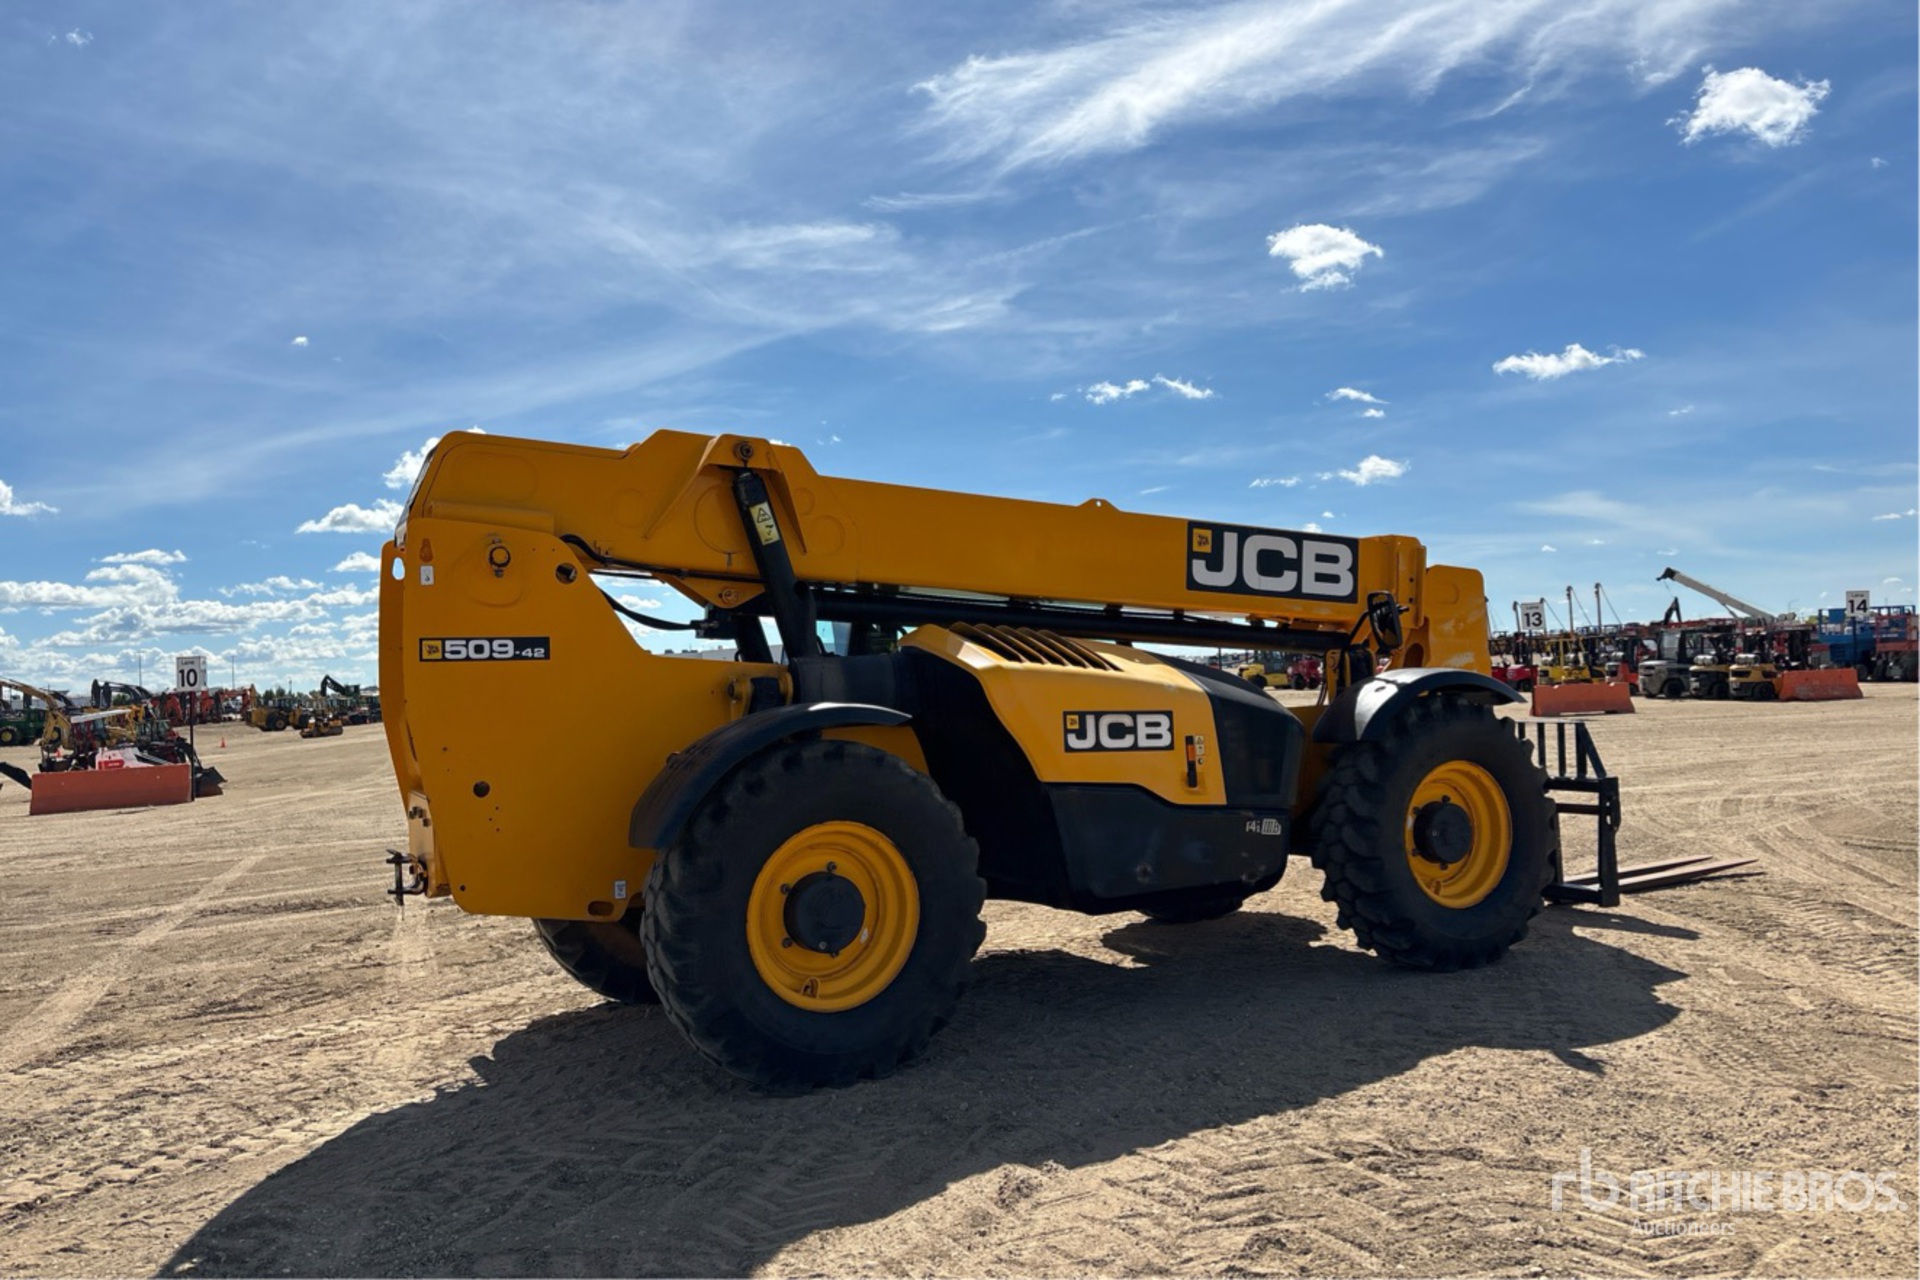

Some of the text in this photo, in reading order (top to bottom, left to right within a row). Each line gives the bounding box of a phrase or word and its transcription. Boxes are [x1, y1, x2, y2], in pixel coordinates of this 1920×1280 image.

[1192, 531, 1354, 597] JCB
[1848, 599, 1868, 614] 14
[1524, 612, 1543, 627] 13
[179, 668, 198, 687] 10
[1067, 714, 1172, 749] JCB
